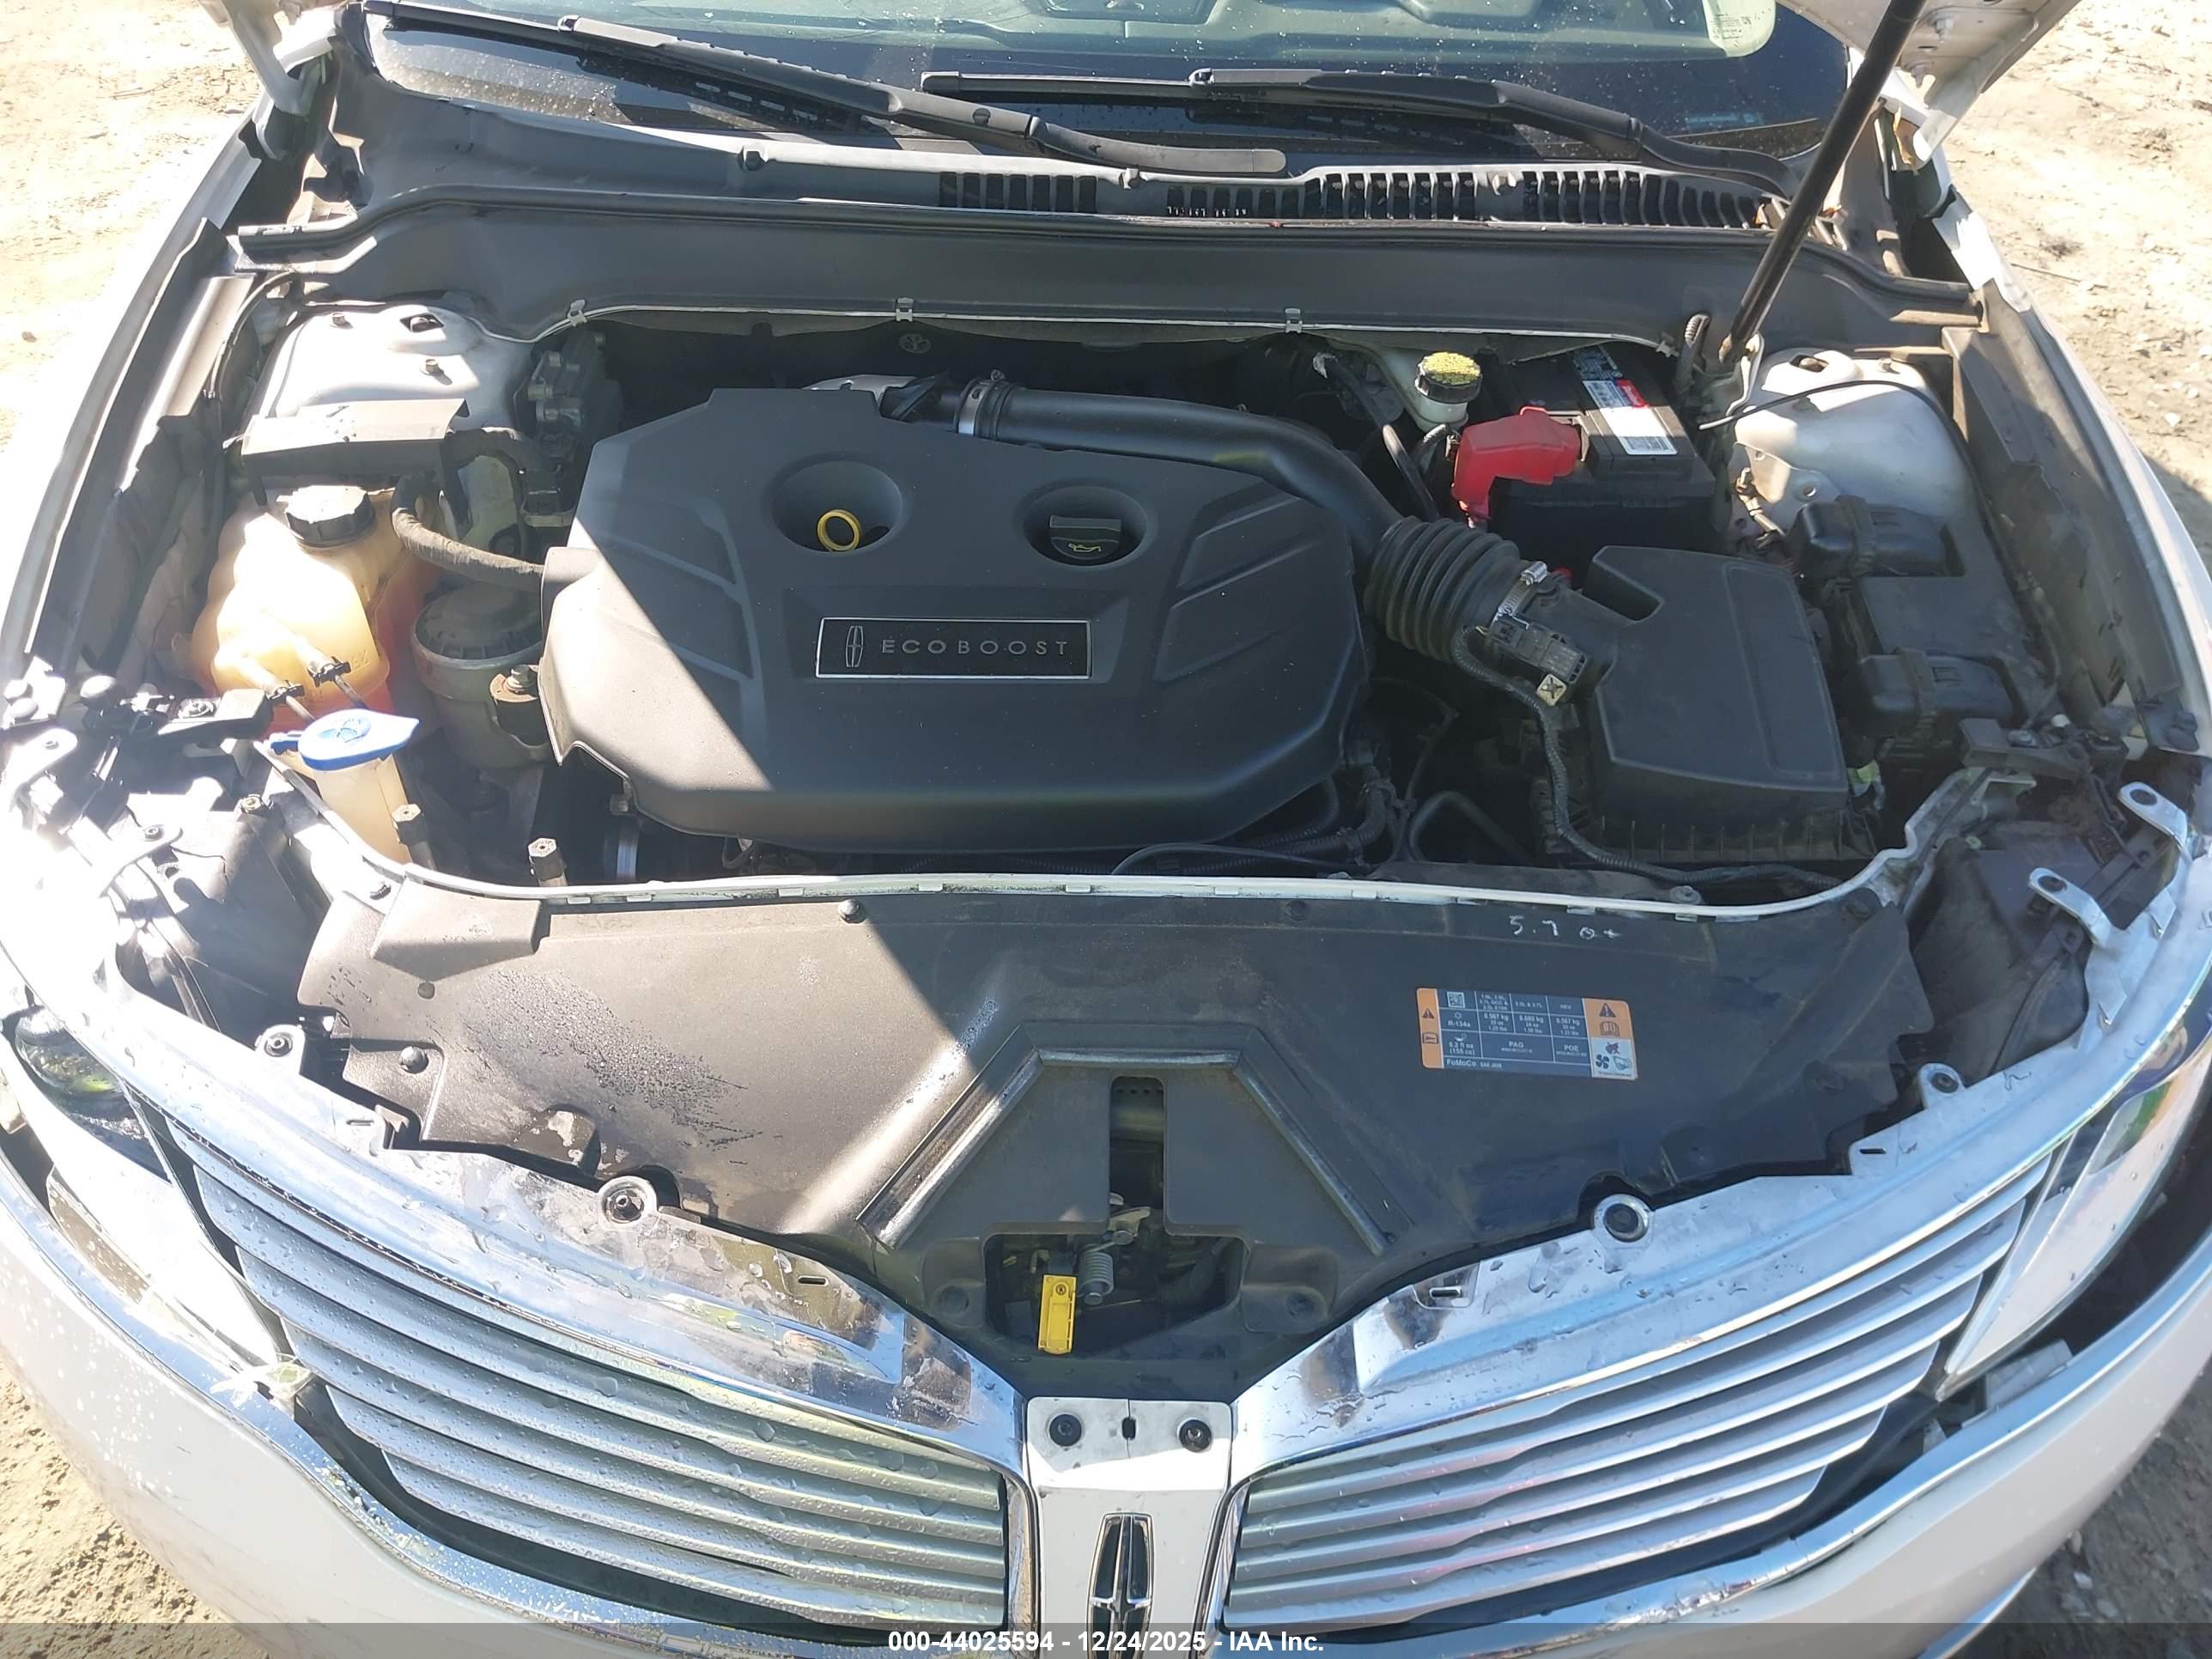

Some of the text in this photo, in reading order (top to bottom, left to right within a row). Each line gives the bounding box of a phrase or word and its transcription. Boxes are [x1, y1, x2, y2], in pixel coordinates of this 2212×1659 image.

[882, 639, 1067, 655] ECOBOOST
[1500, 1013, 1509, 1022] kg
[1572, 1018, 1580, 1026] kg
